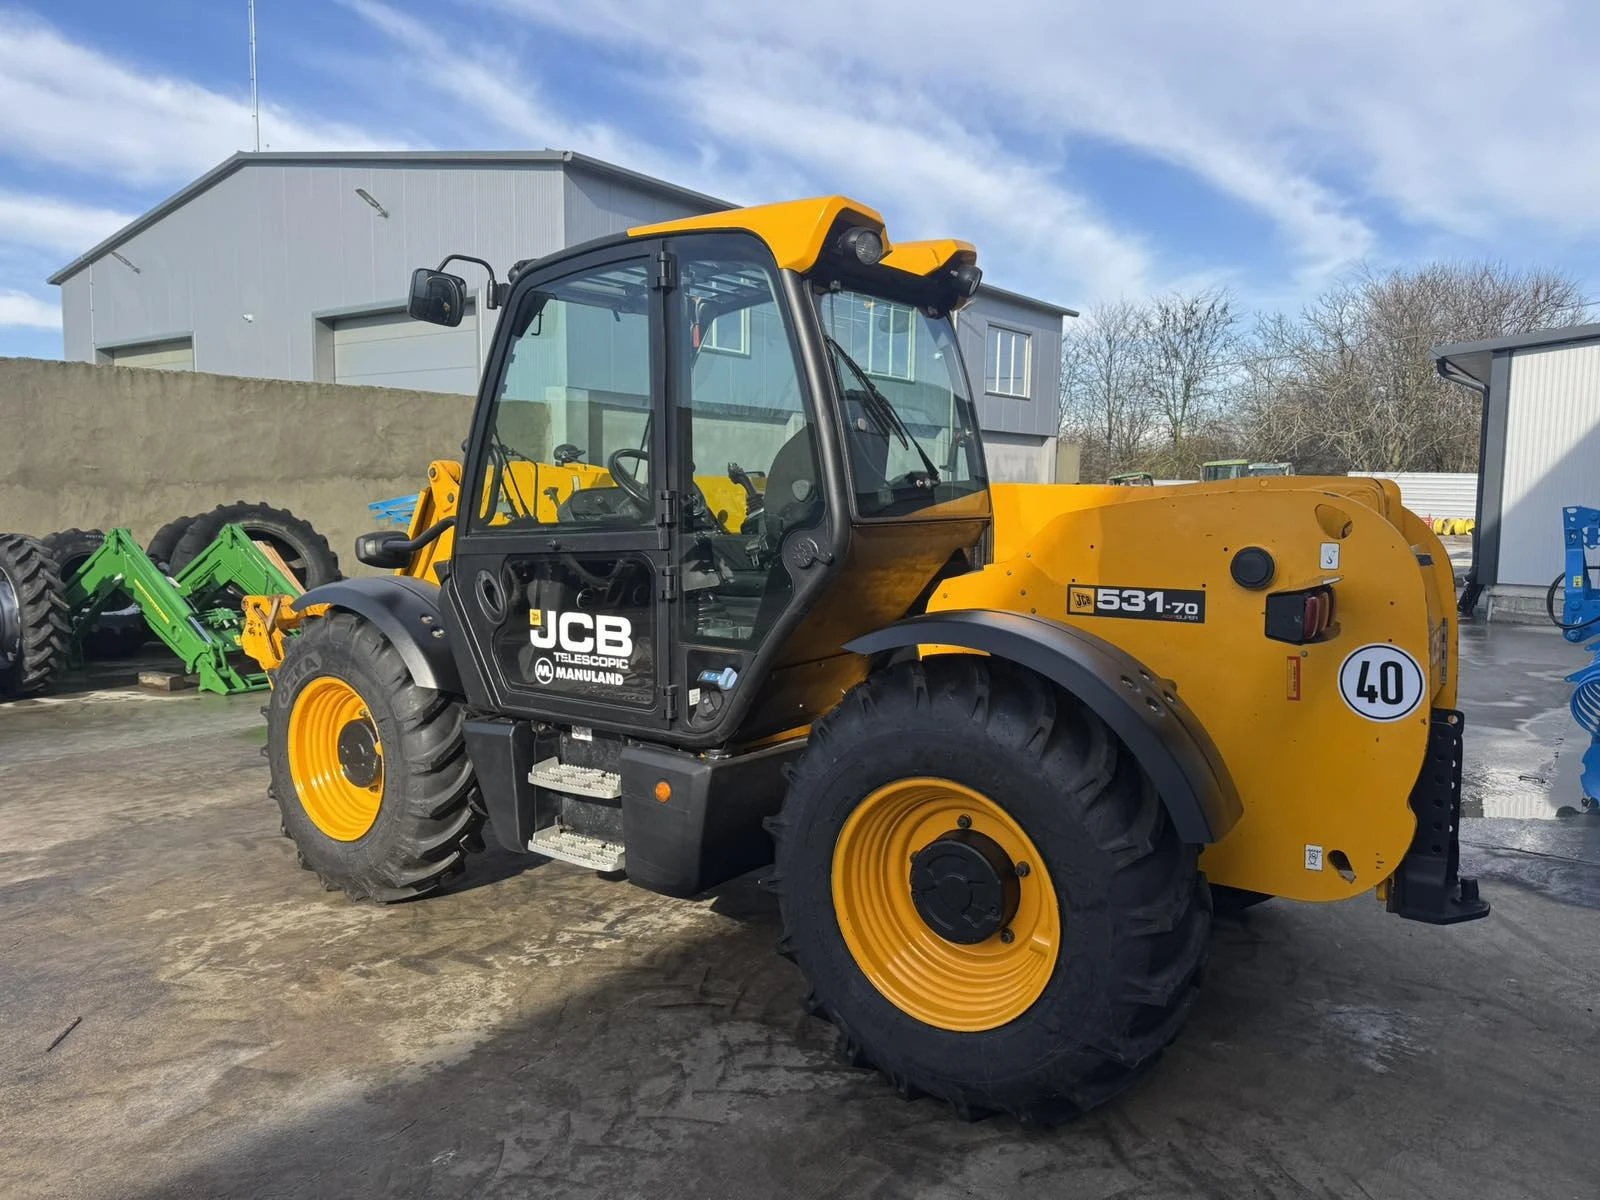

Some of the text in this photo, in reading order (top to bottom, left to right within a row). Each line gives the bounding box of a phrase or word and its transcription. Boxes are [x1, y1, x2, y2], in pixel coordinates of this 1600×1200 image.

[1096, 588, 1198, 615] 531-70
[530, 610, 633, 657] JCB
[553, 652, 629, 669] TELESCOPIC
[555, 666, 624, 686] MANULAND
[1356, 660, 1404, 705] 40
